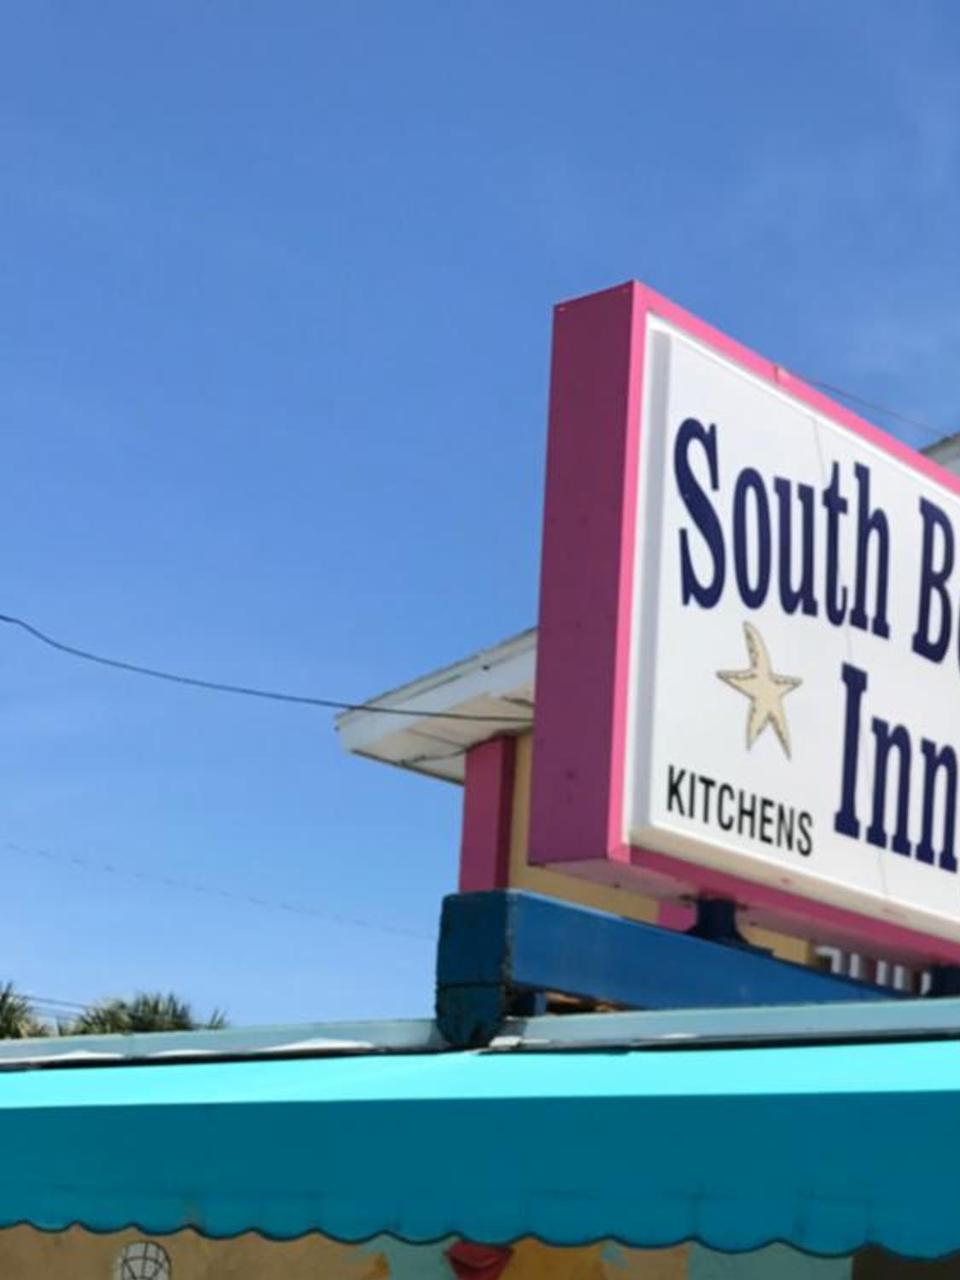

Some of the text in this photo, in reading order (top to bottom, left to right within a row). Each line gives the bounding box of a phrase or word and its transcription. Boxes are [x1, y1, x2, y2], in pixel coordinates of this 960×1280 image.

[673, 417, 891, 640] South
[667, 765, 812, 857] KITCHENS
[834, 661, 958, 873] Inn
